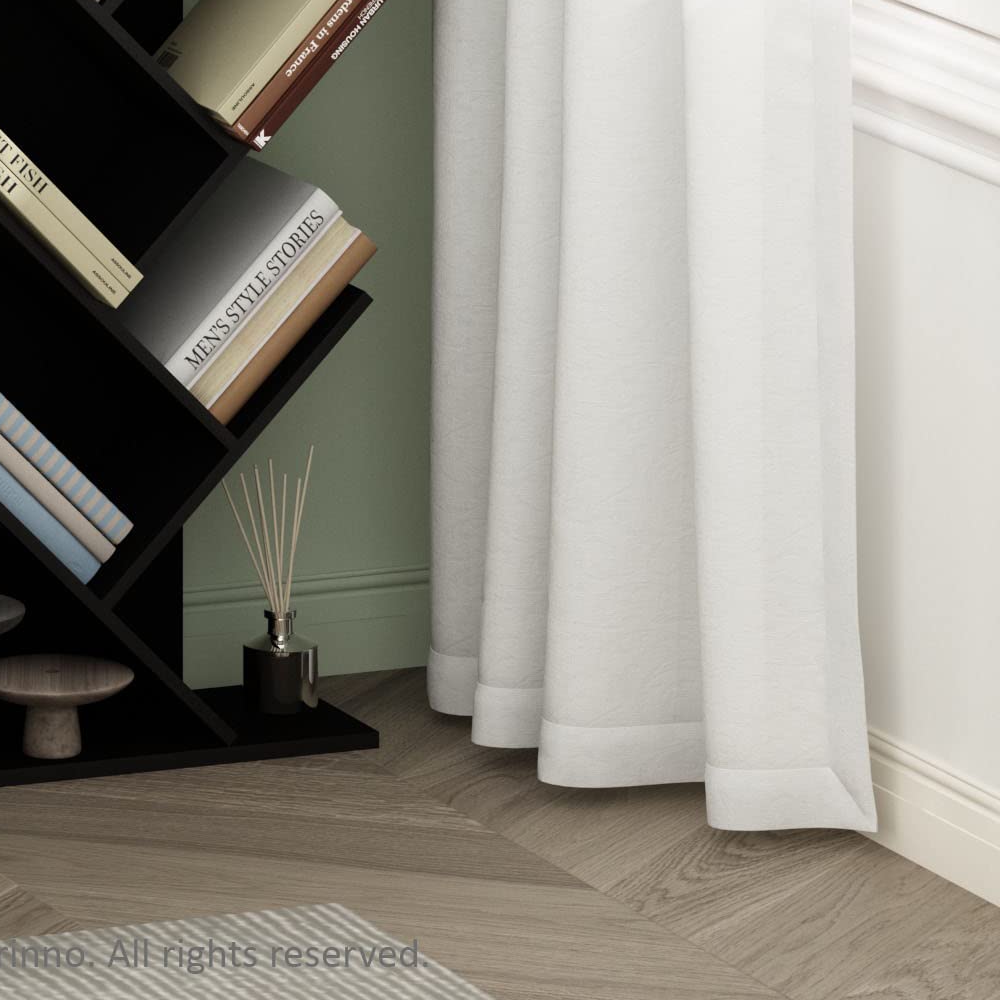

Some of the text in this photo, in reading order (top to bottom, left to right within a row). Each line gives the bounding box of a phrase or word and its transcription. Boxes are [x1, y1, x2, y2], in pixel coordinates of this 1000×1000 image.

[316, 27, 330, 40] in
[331, 24, 362, 60] HOUSING
[285, 39, 319, 78] France
[10, 154, 48, 194] FISH
[184, 209, 324, 370] MEN'S STYLE STORIES
